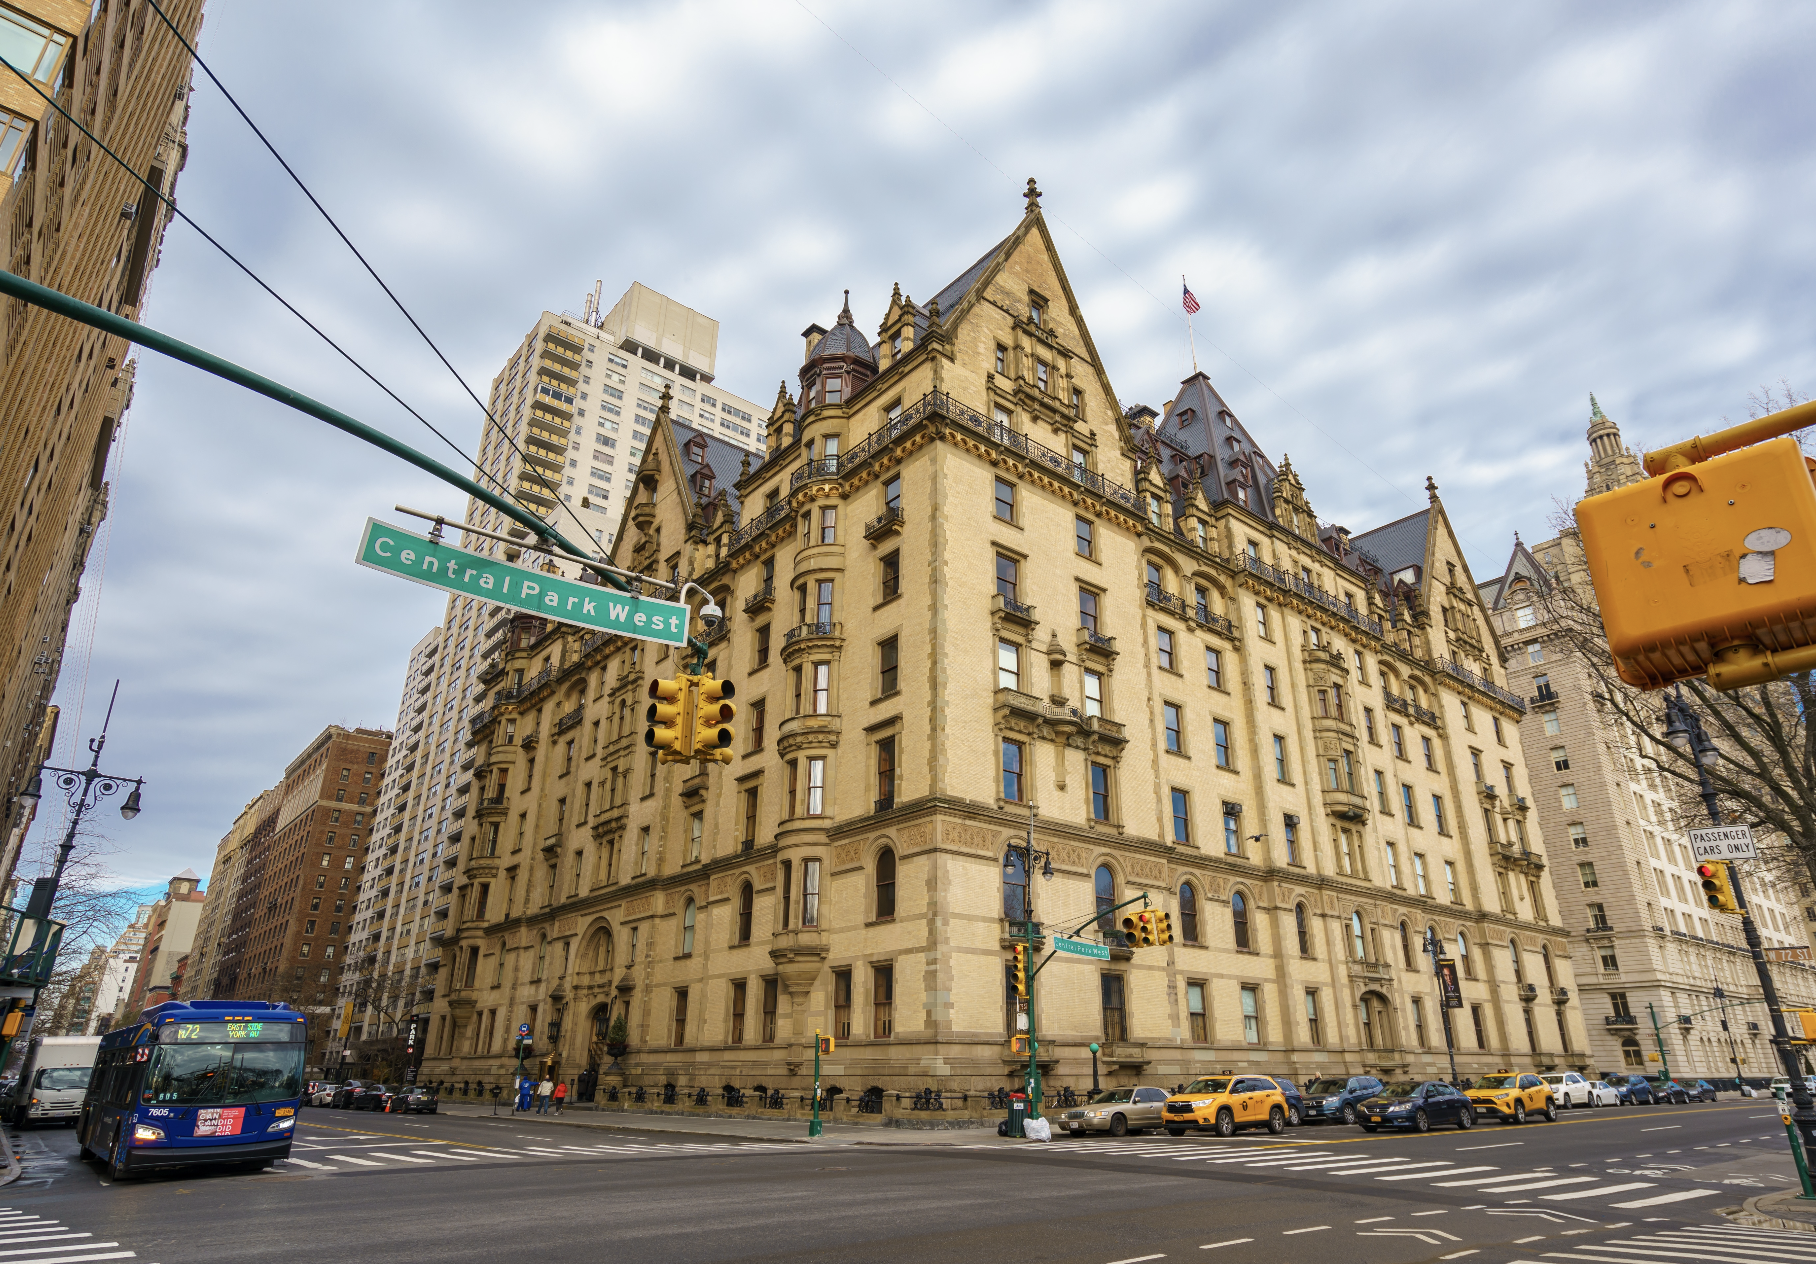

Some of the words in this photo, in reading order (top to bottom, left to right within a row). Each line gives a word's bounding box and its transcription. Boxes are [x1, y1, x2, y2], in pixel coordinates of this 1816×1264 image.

[374, 537, 510, 593] Central
[521, 580, 597, 616] Park
[608, 601, 679, 633] West
[1693, 829, 1748, 843] PASSENGER
[1697, 844, 1721, 856] CARS
[1727, 842, 1750, 853] ONLY
[1767, 950, 1776, 961] W
[1779, 950, 1793, 960] 72
[1796, 949, 1809, 960] ST
[177, 1024, 200, 1039] M72
[229, 1030, 247, 1038] YORK
[408, 1023, 417, 1045] PARK
[148, 1108, 170, 1117] 7605
